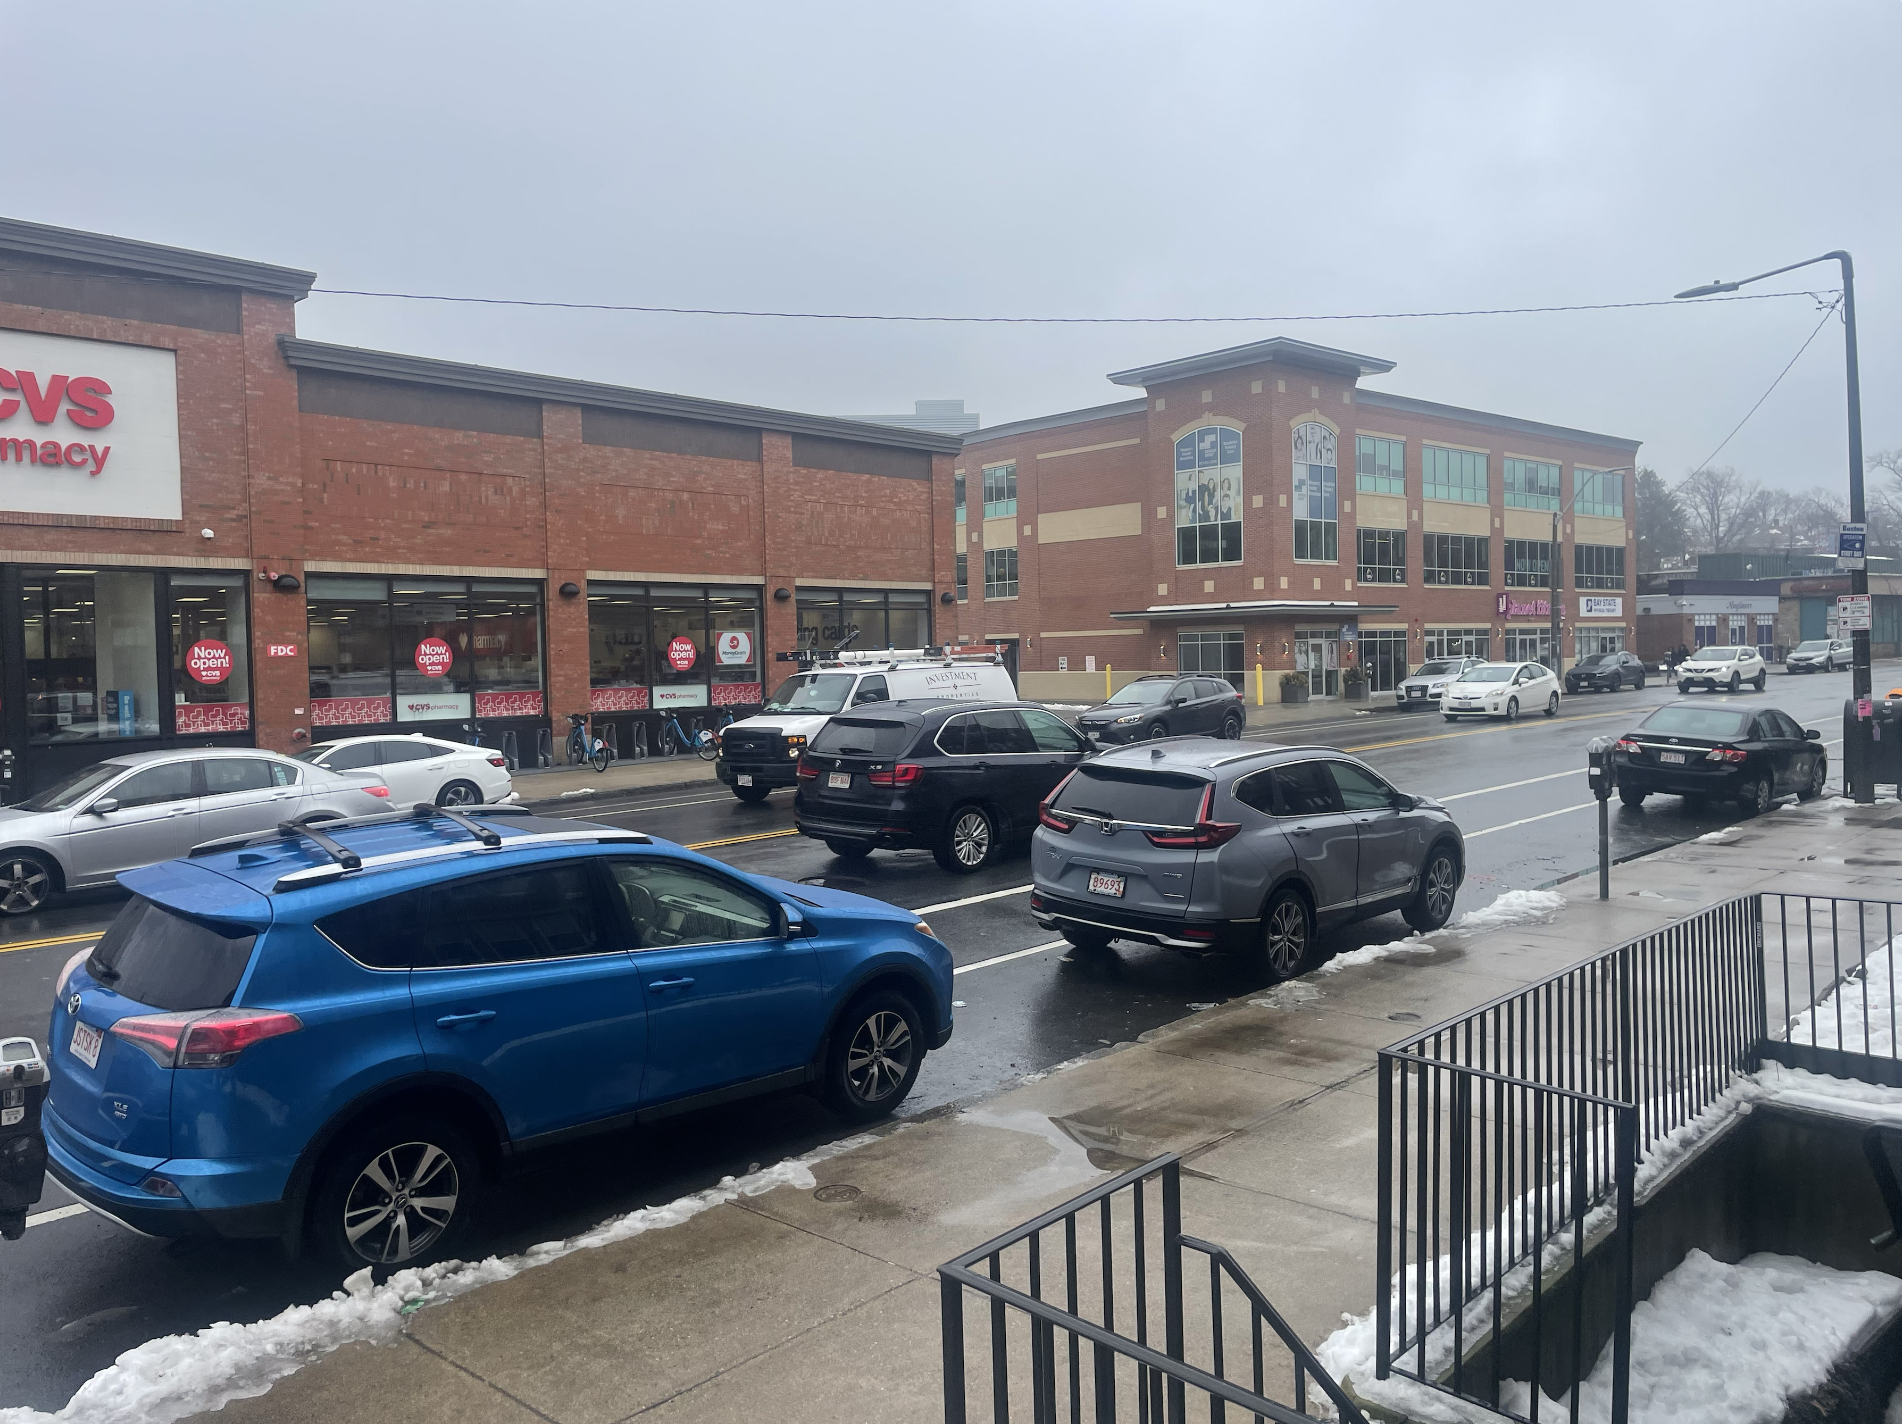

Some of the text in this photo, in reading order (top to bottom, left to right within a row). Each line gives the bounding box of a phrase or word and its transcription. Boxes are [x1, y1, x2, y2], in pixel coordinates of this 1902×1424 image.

[1593, 598, 1617, 607] BAY STATE
[270, 645, 294, 656] FDC
[421, 644, 446, 654] Now
[672, 641, 692, 651] Now
[194, 646, 226, 658] Now
[671, 649, 693, 660] open!
[191, 656, 229, 670] open!
[418, 652, 449, 665] open!
[925, 671, 977, 685] INVESTMENT
[415, 703, 459, 711] CVS pharmacy
[1092, 876, 1121, 892] 89693
